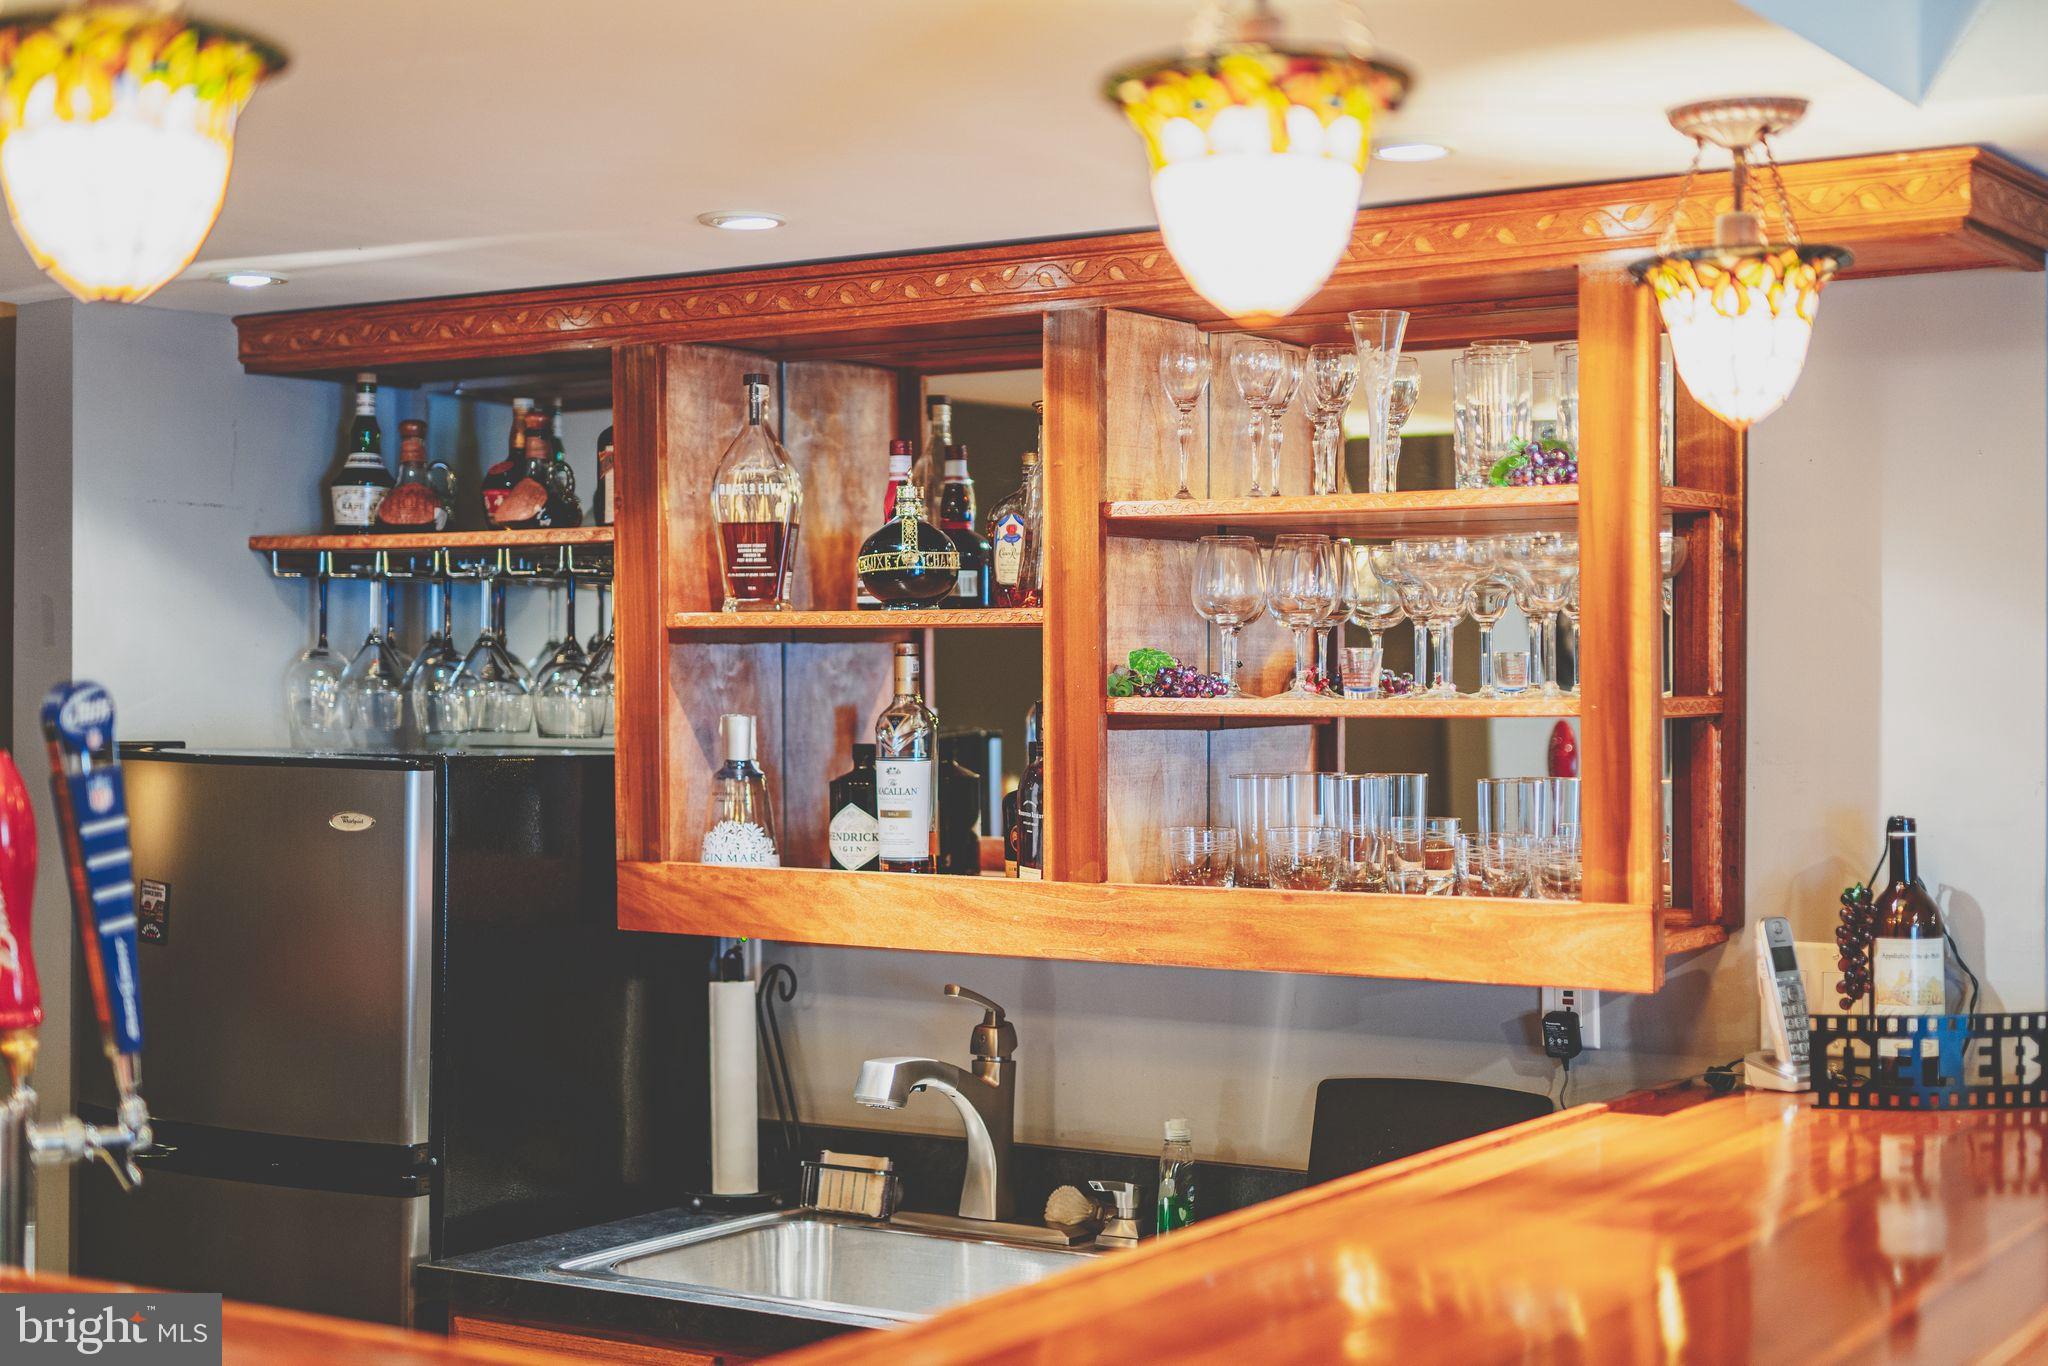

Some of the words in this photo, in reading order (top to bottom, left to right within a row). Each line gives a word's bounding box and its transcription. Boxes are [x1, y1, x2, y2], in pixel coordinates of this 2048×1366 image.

[830, 832, 880, 842] ENDRICK
[704, 854, 722, 862] GIN
[727, 853, 766, 863] MARE
